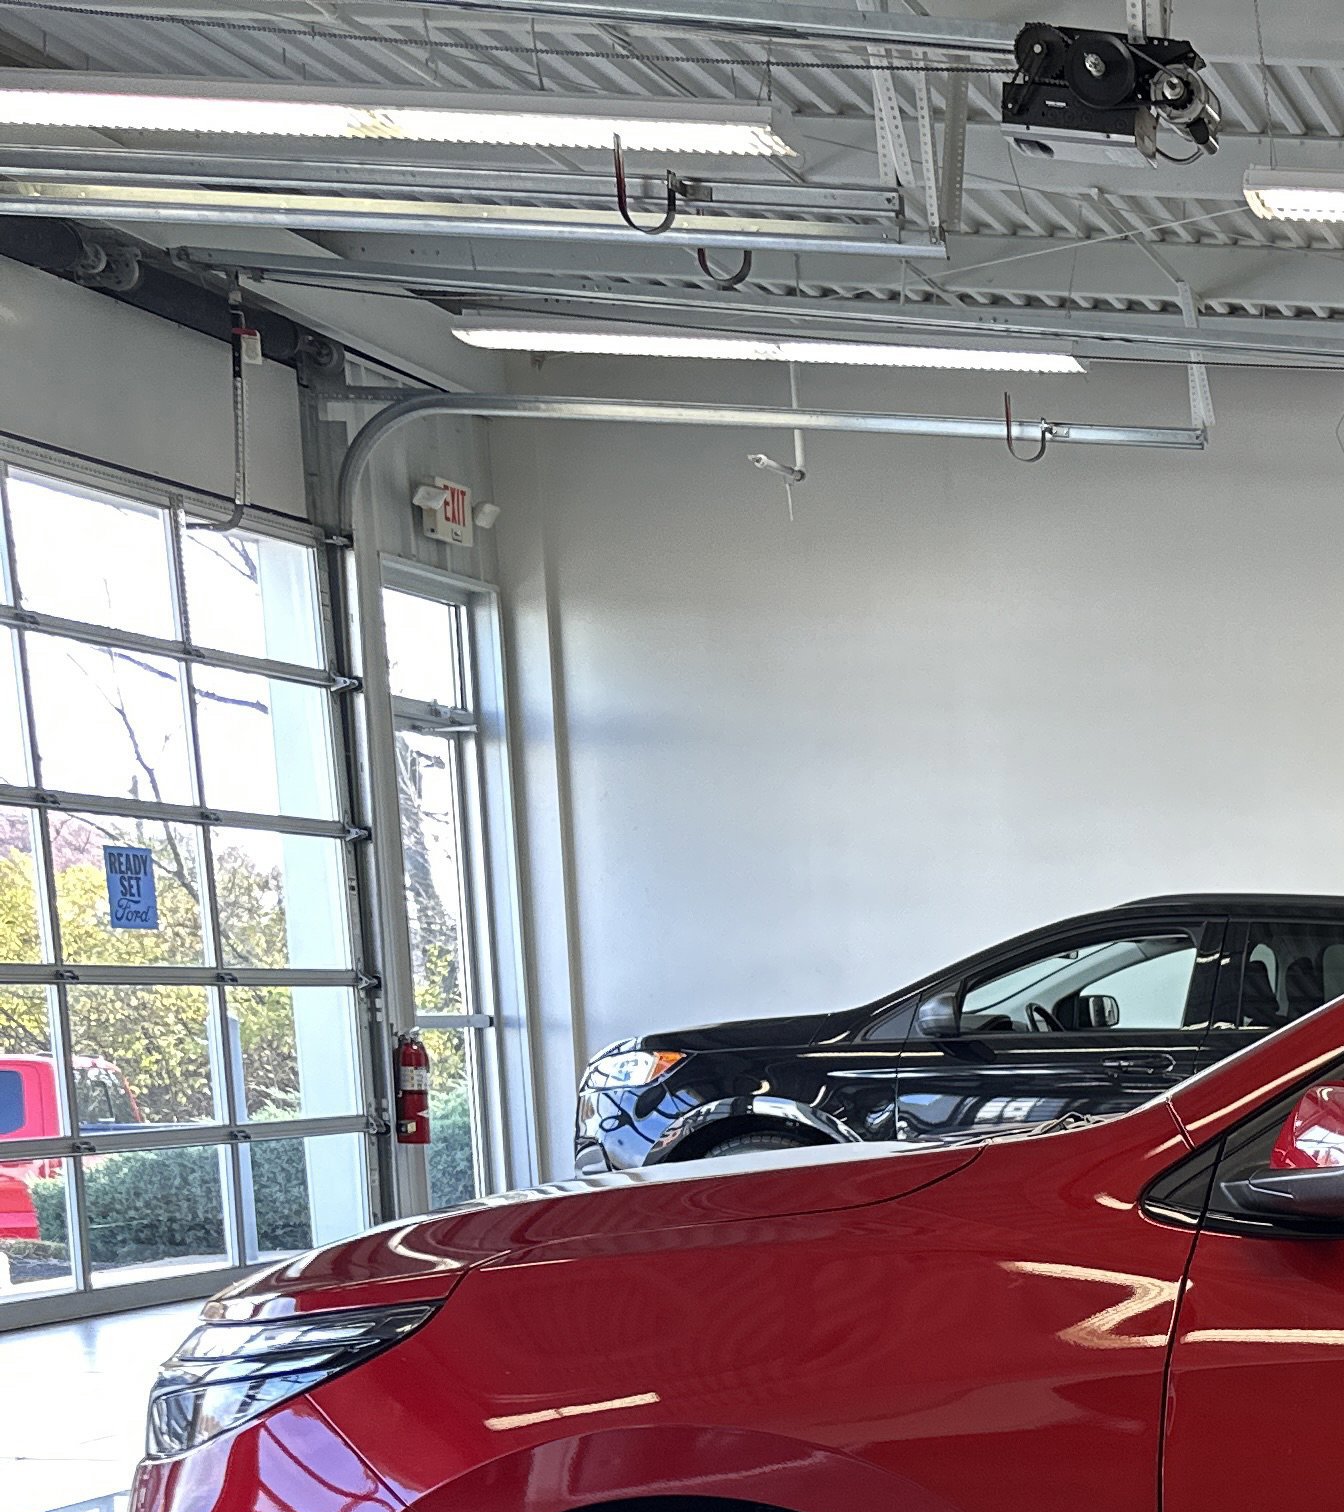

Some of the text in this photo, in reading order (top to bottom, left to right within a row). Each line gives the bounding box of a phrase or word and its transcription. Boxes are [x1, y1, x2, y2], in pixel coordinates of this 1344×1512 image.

[443, 484, 467, 527] EXIT
[107, 852, 148, 877] READY
[119, 875, 142, 898] SET
[115, 897, 151, 923] Ford
